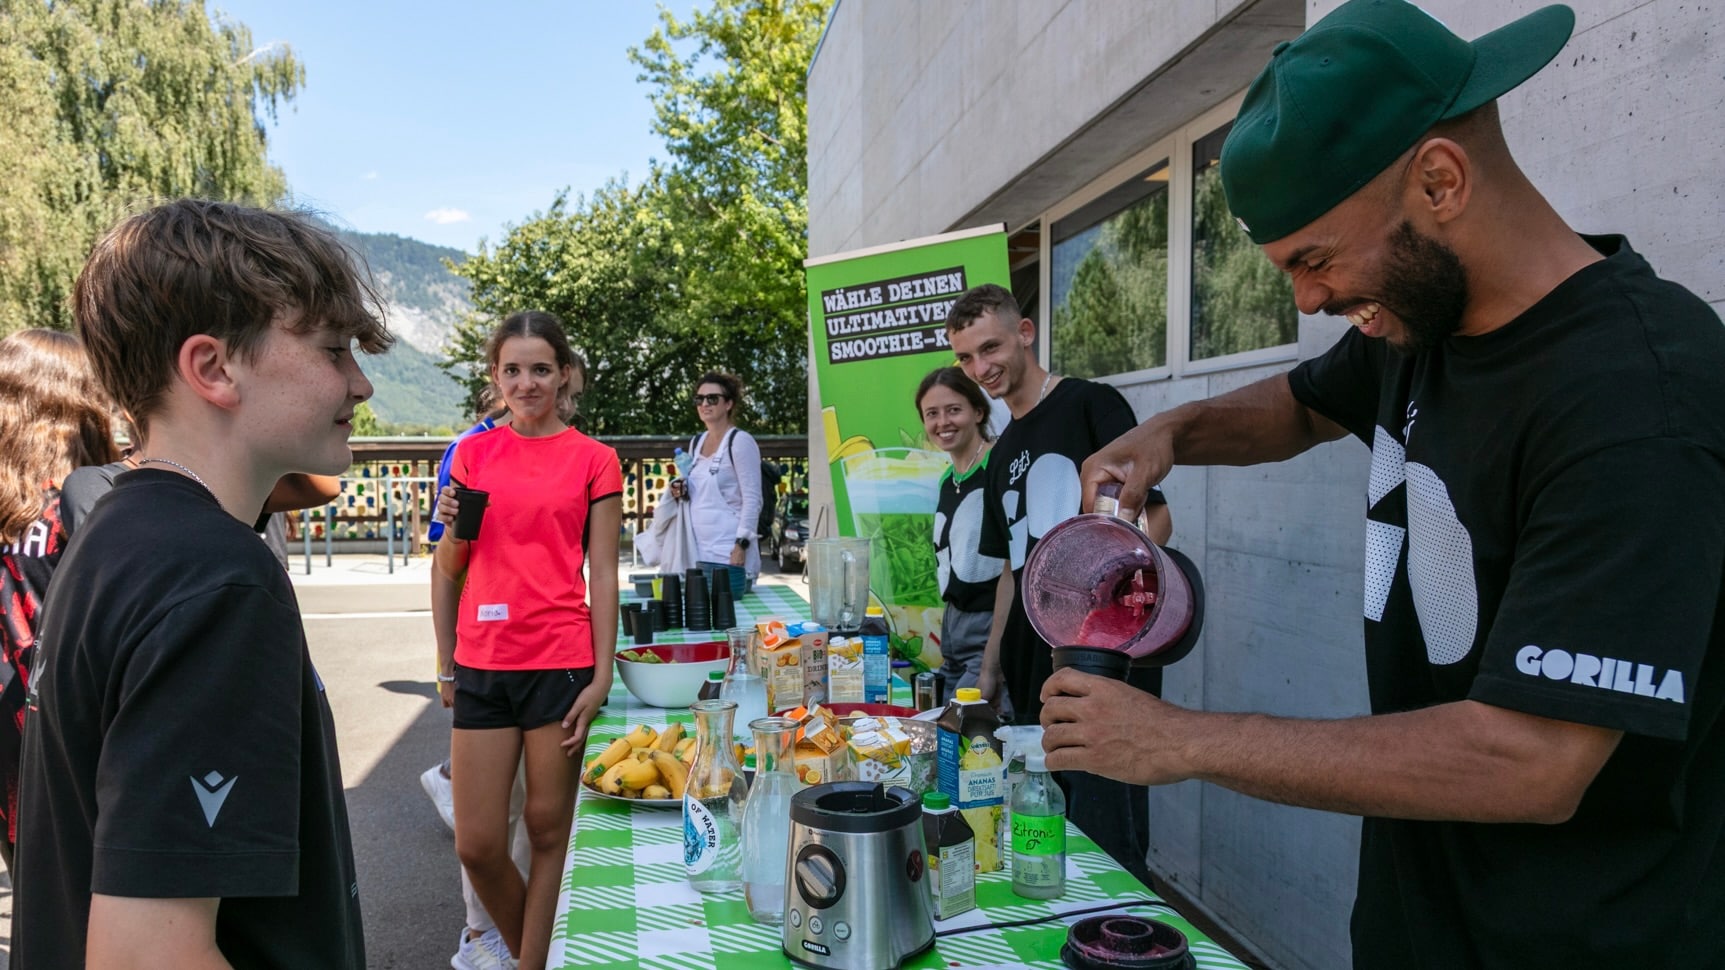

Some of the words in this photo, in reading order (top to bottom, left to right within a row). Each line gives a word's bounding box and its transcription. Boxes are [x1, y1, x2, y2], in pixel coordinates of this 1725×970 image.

[824, 288, 883, 313] WÄHLE
[888, 272, 963, 302] DEINEN
[826, 299, 957, 336] ULTIMATIVEN
[831, 327, 952, 361] SMOOTHIE-K
[1009, 449, 1031, 486] Let's
[1514, 644, 1685, 704] GORILLA
[967, 777, 996, 786] ANANAS
[690, 803, 702, 814] OF
[701, 814, 716, 849] WATER
